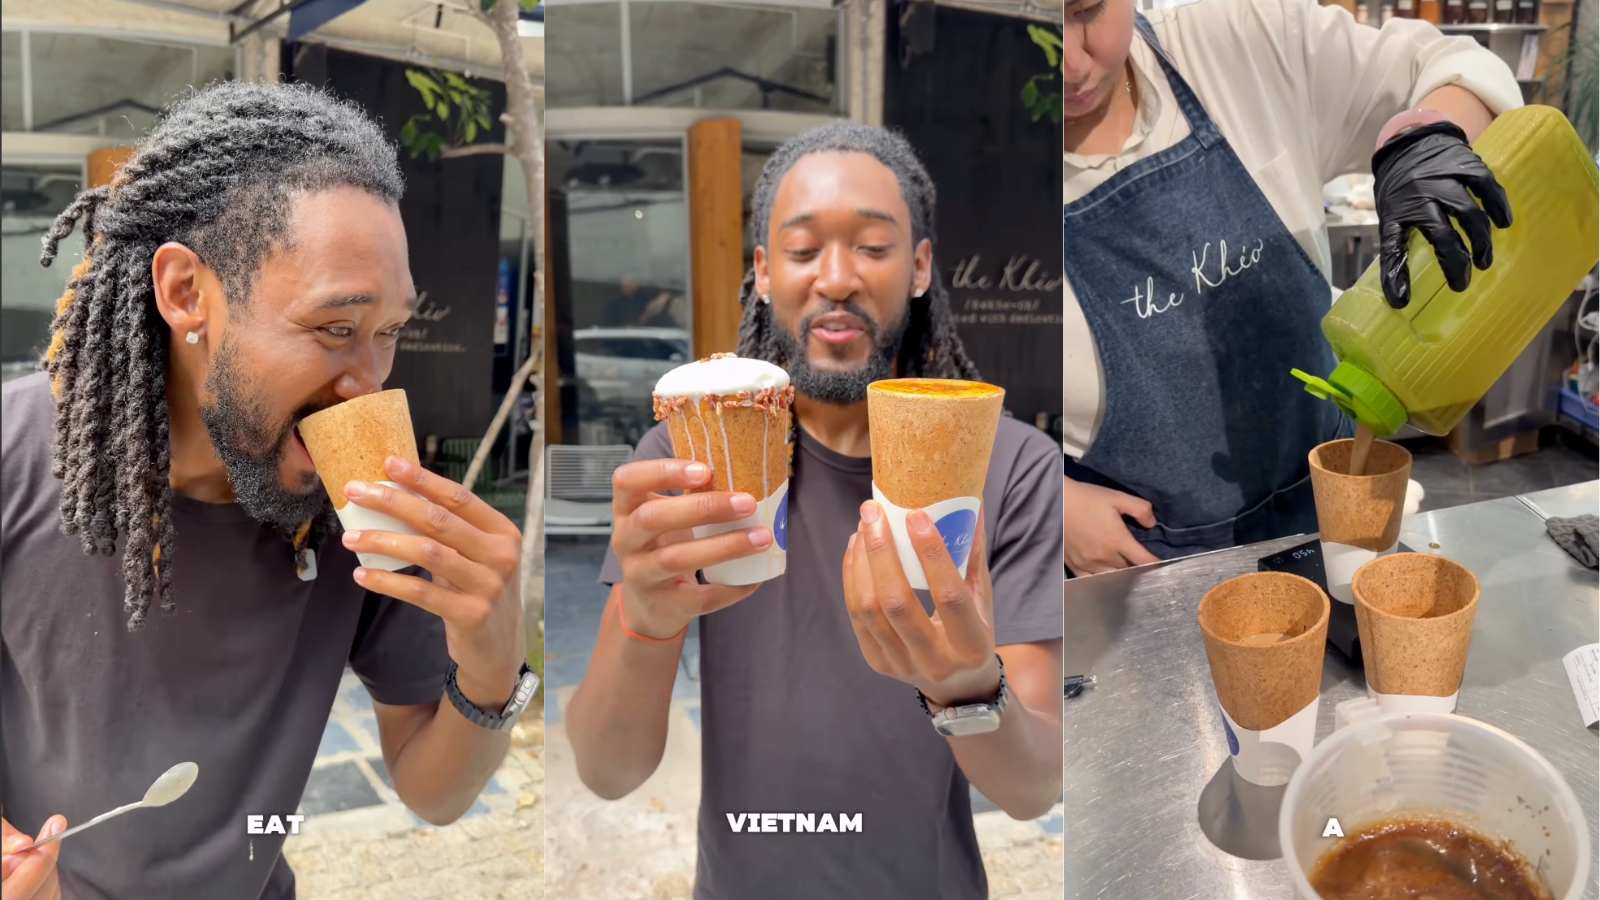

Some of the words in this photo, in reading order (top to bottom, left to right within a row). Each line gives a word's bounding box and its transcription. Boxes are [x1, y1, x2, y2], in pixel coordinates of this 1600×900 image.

[947, 253, 993, 289] the
[1120, 276, 1184, 319] the
[1191, 238, 1264, 294] Khéo
